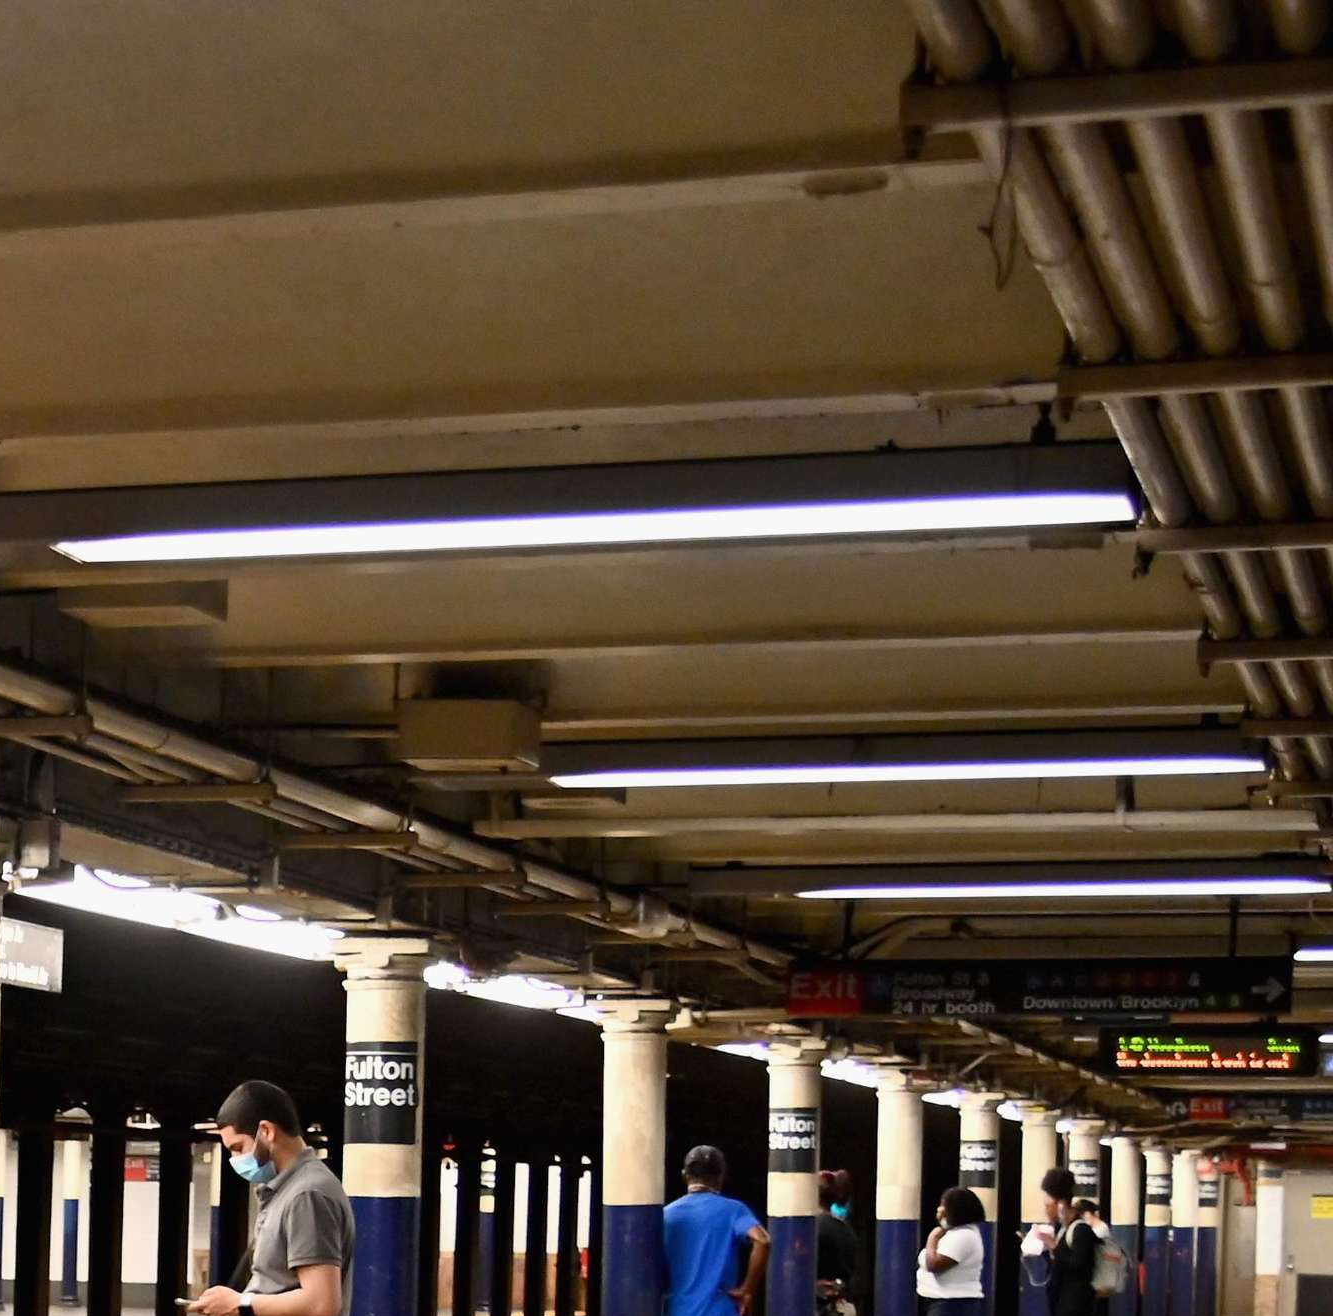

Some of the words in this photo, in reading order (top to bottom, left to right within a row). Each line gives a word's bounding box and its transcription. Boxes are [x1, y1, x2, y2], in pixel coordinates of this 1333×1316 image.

[790, 972, 858, 999] Exit
[892, 1001, 914, 1015] 24
[946, 1001, 997, 1015] booth
[345, 1055, 414, 1080] Fulton
[344, 1082, 415, 1106] Street
[769, 1116, 815, 1132] Fulton
[769, 1133, 816, 1149] Street
